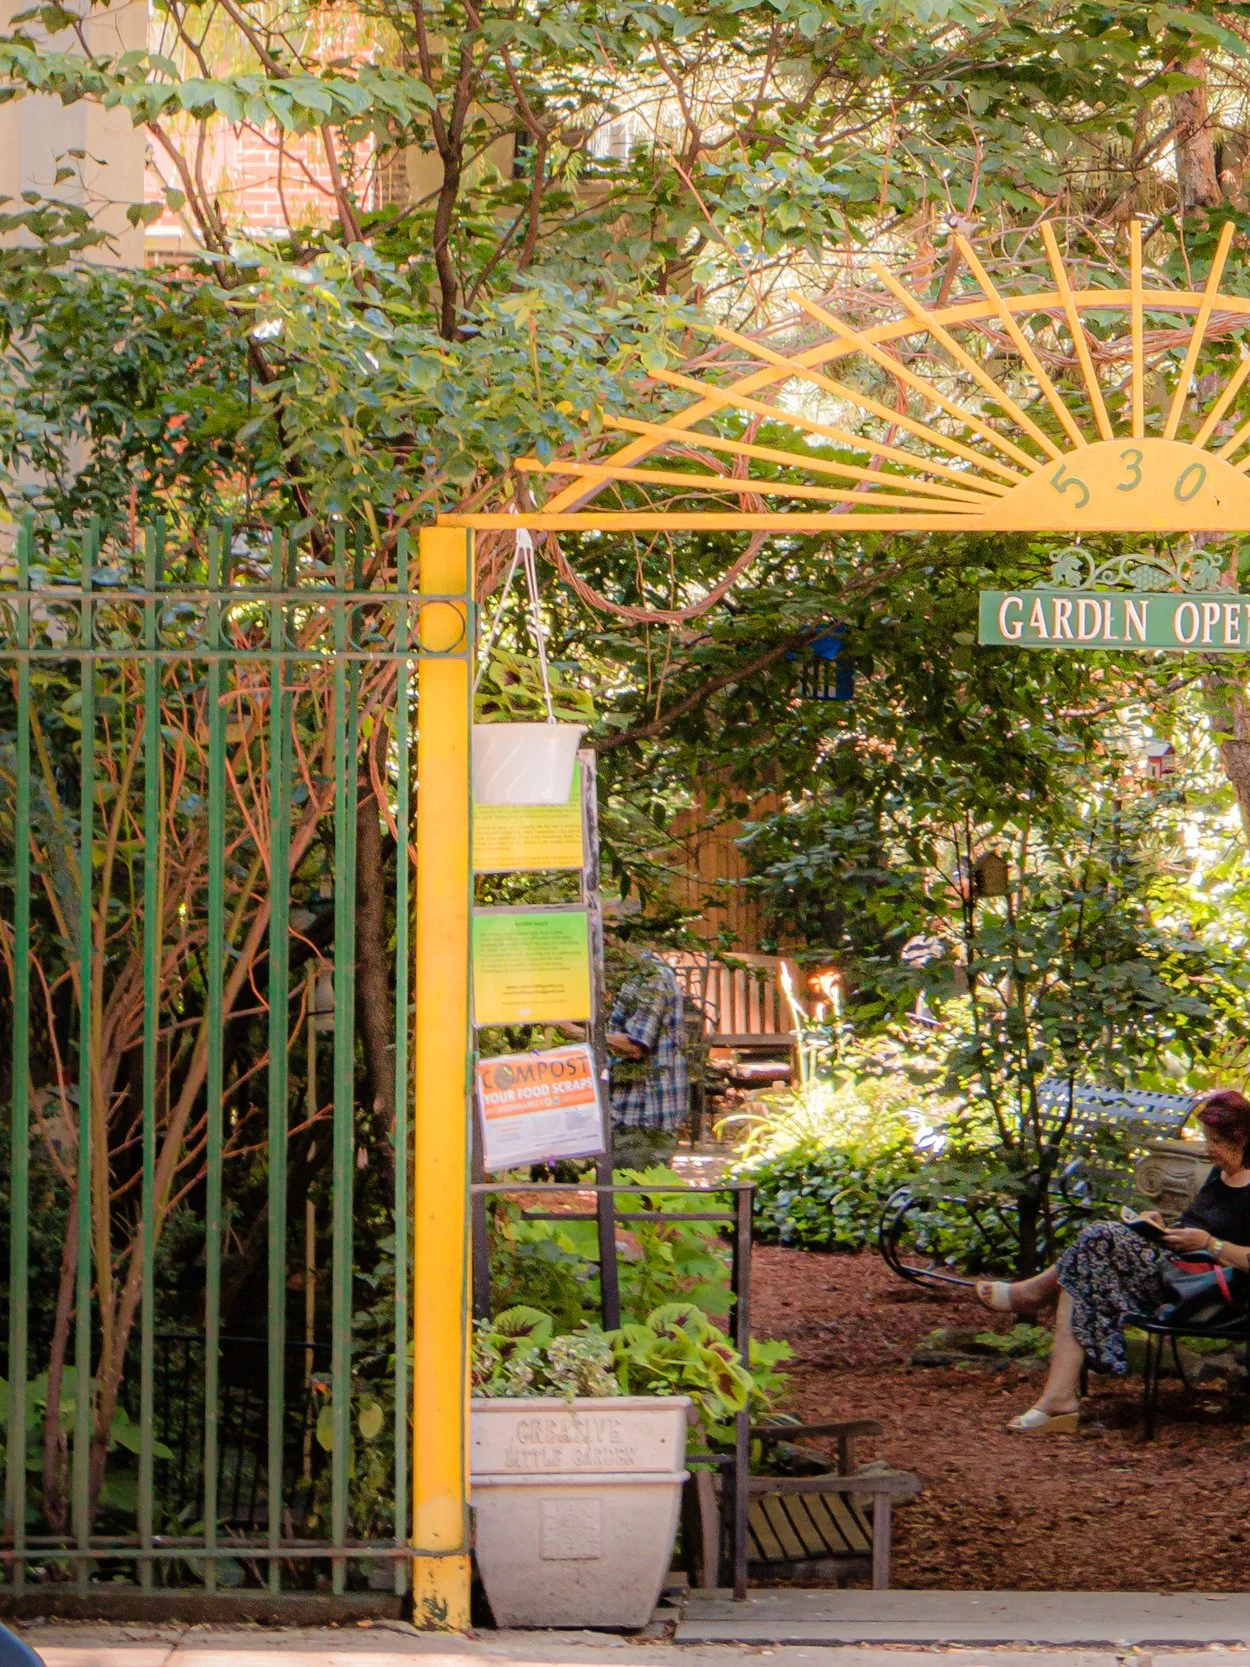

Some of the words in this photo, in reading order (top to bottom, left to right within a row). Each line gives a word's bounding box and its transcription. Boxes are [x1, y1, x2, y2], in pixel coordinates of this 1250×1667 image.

[998, 596, 1149, 642] GARDEN
[483, 1089, 516, 1105] YOUR
[518, 1084, 550, 1100] FOOD
[552, 1077, 593, 1094] SCRAPS
[516, 1416, 624, 1444] CREATIVE
